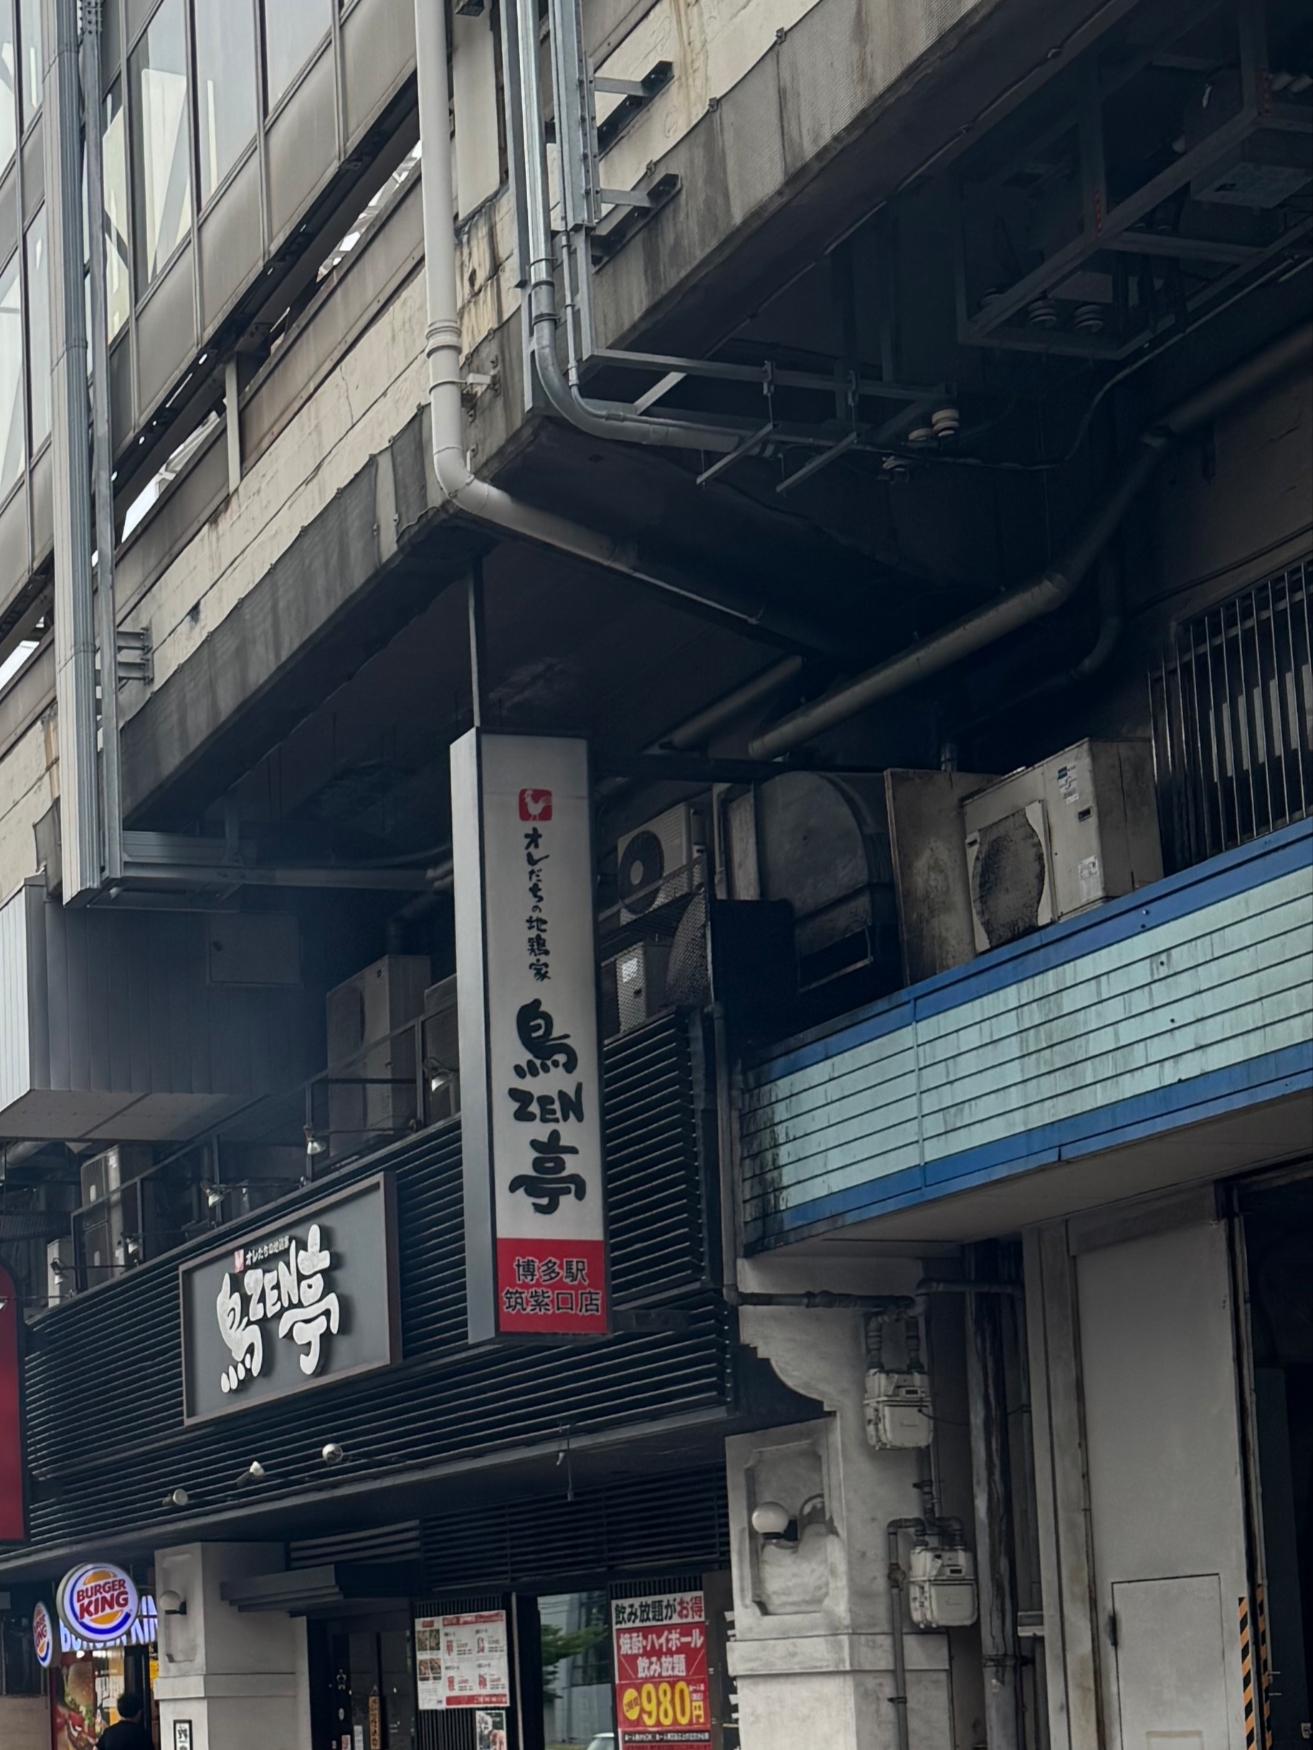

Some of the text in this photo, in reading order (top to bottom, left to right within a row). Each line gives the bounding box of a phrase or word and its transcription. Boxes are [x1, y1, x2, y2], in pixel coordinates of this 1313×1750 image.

[514, 1257, 588, 1284] 博多駅
[503, 1287, 602, 1317] 筑紫口店
[76, 1578, 126, 1603] BURGER
[77, 1590, 129, 1622] KING
[614, 1596, 703, 1625] 飲み放題がお得
[637, 1654, 686, 1678] 飲み放題
